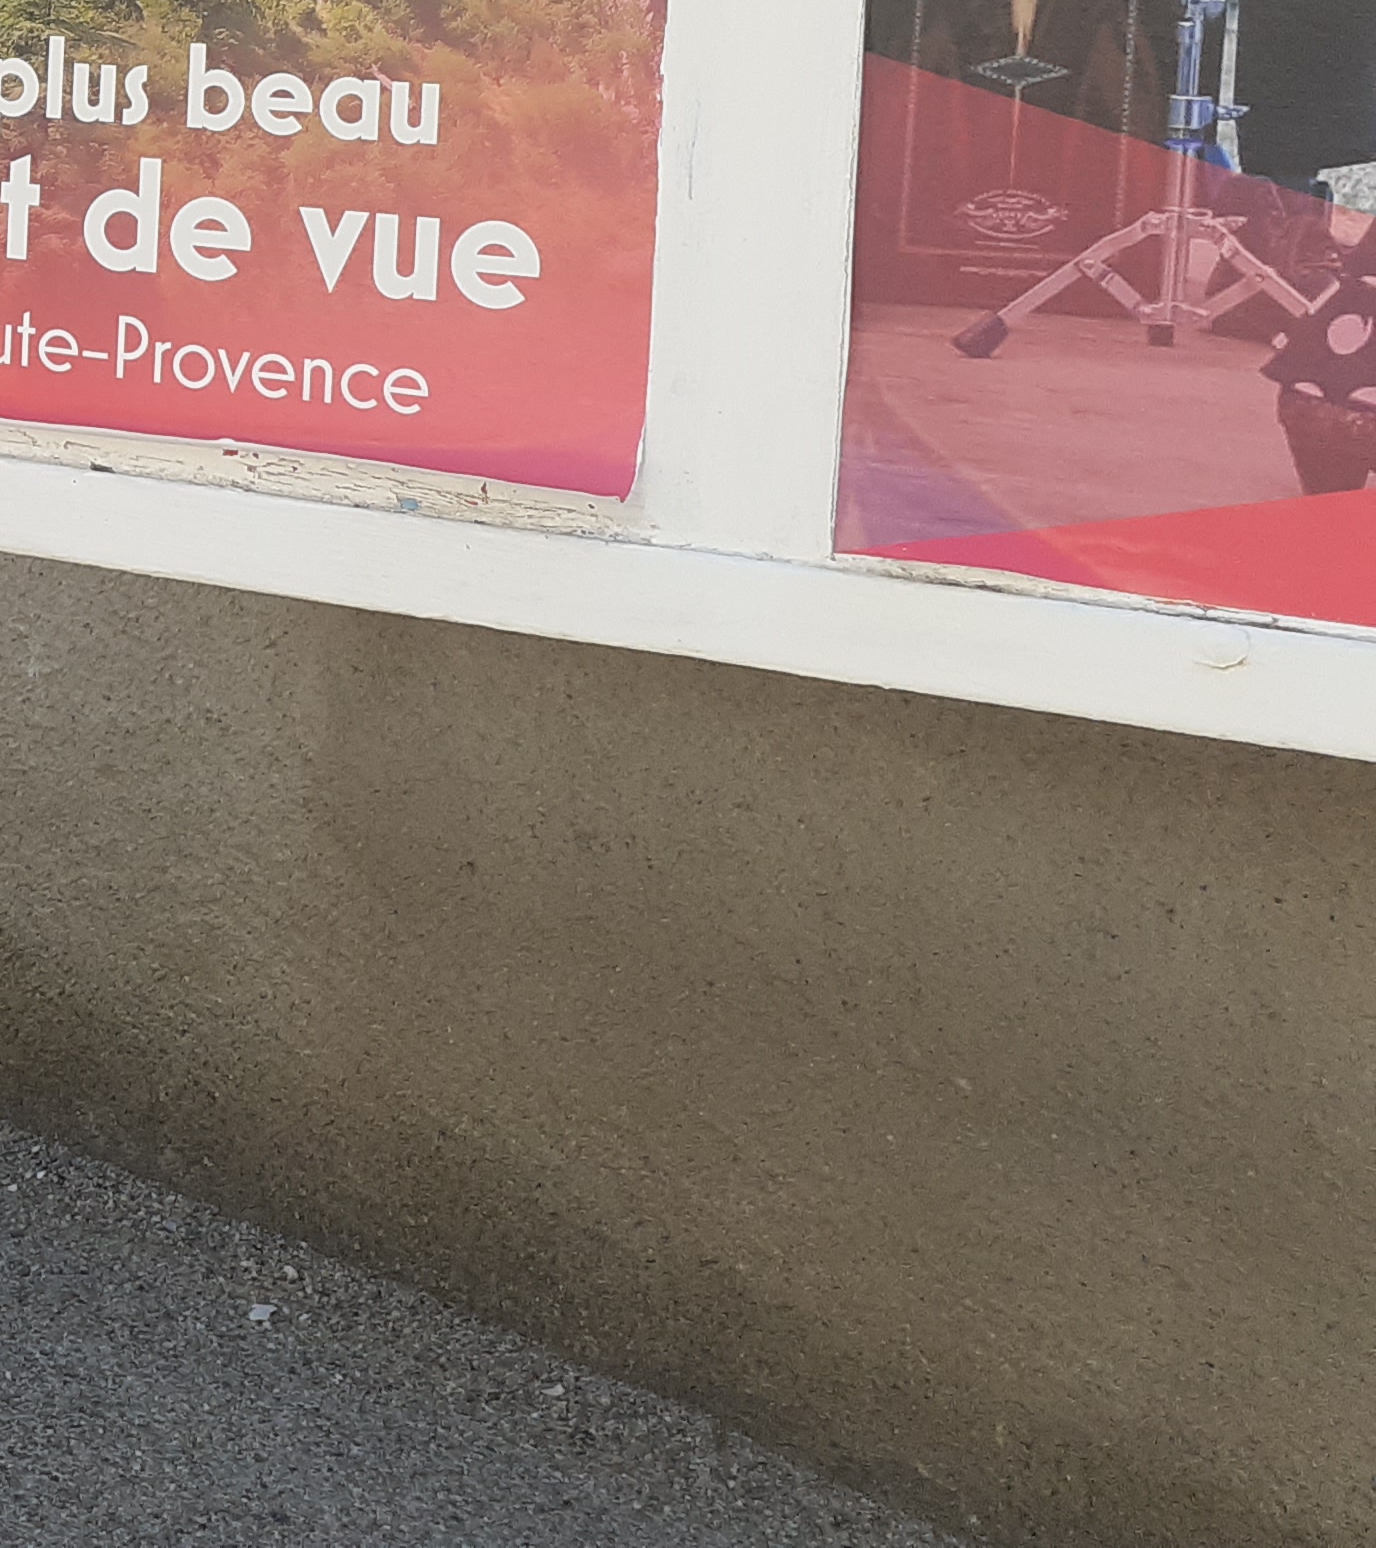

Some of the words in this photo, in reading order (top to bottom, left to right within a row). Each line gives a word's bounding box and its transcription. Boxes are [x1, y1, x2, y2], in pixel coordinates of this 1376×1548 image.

[187, 43, 441, 145] beau
[83, 158, 252, 281] de
[299, 205, 541, 310] vue
